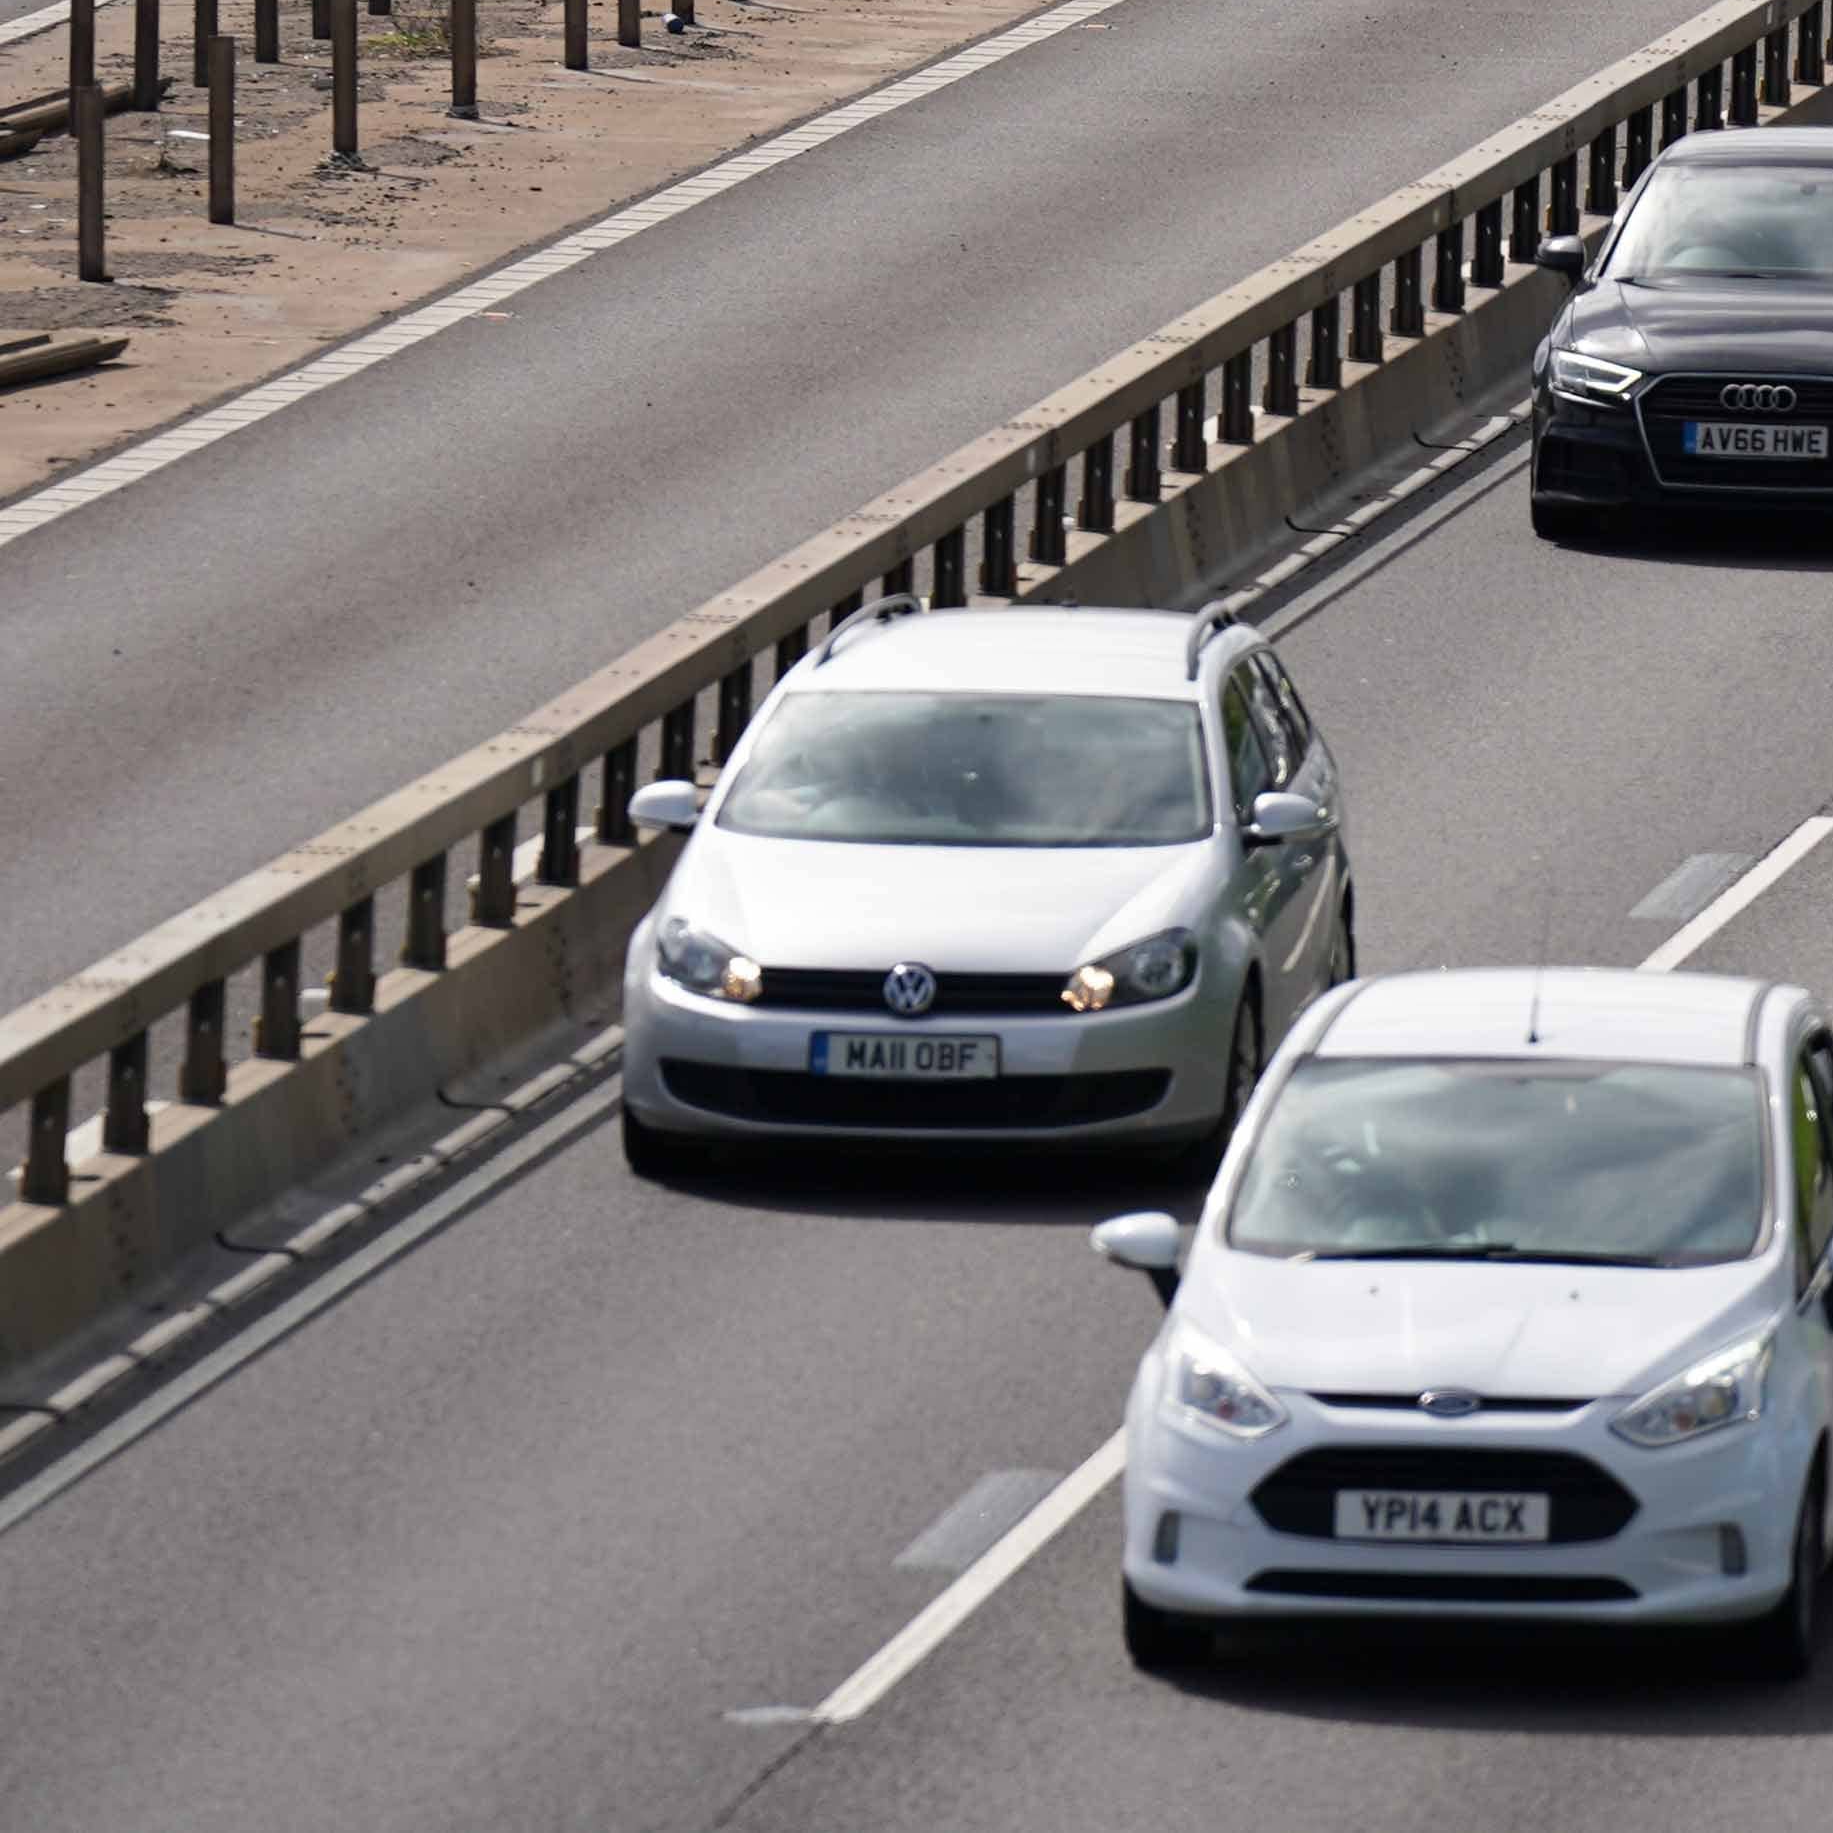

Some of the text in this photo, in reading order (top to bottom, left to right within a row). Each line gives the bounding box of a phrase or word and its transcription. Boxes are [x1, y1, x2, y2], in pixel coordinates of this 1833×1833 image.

[1698, 425, 1825, 454] AV66 HWE
[845, 1041, 976, 1073] MA11 OBF
[1360, 1497, 1527, 1534] YP14 ACX
